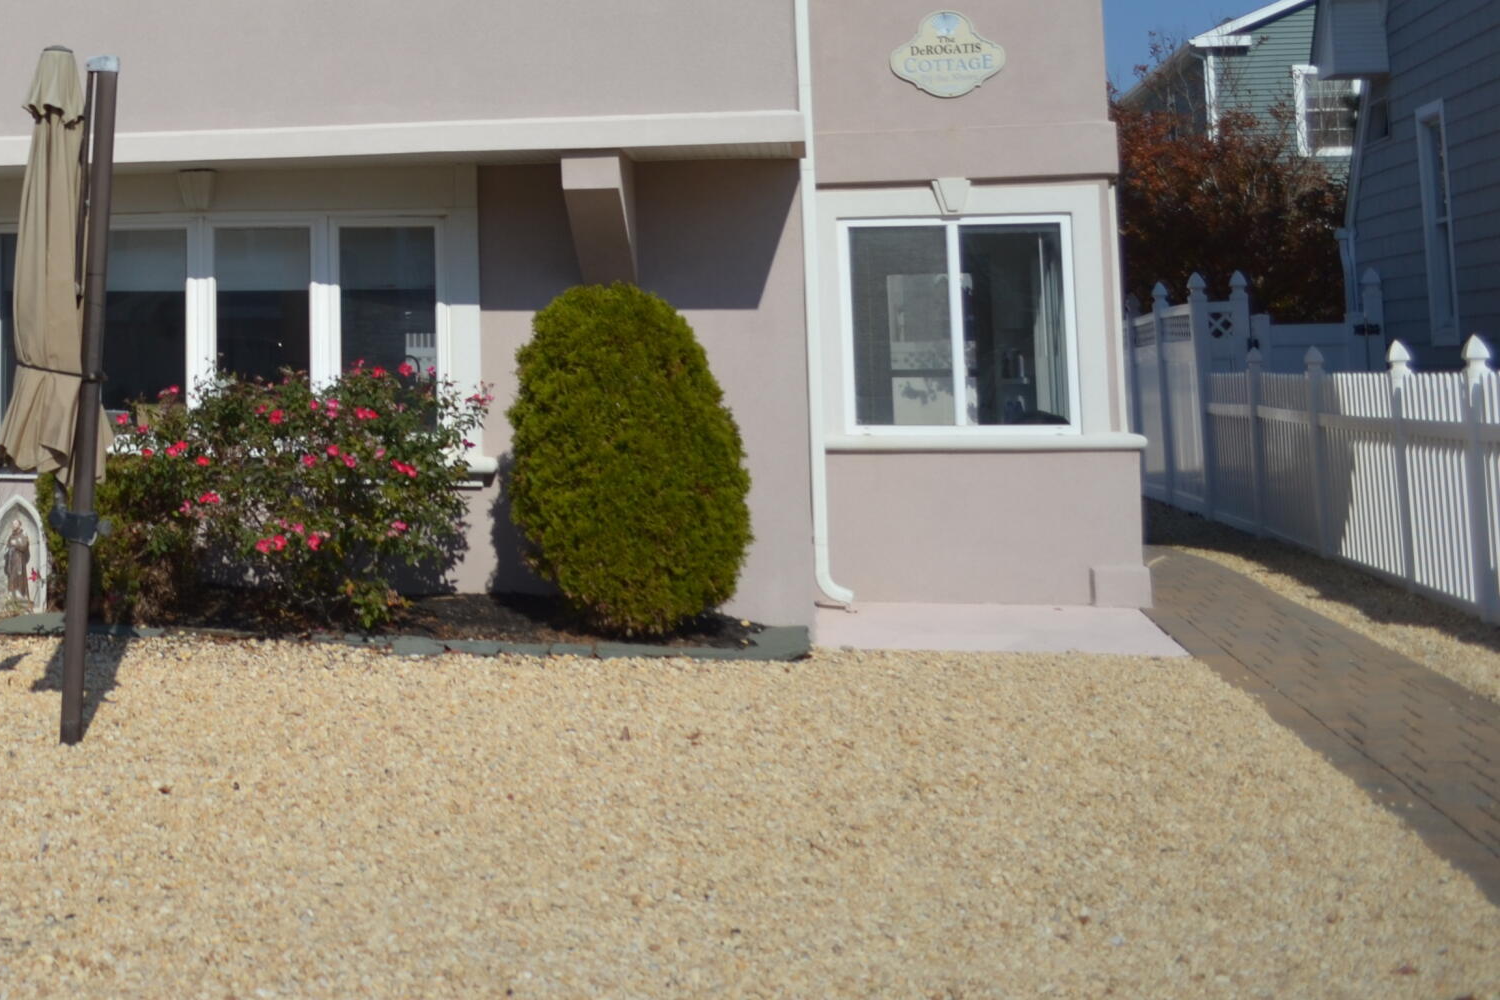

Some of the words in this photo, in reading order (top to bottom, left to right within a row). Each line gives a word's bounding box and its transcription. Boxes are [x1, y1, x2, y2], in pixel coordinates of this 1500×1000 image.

[937, 35, 956, 43] The
[910, 43, 982, 56] DeROGATIS
[903, 54, 993, 73] COTTAGE
